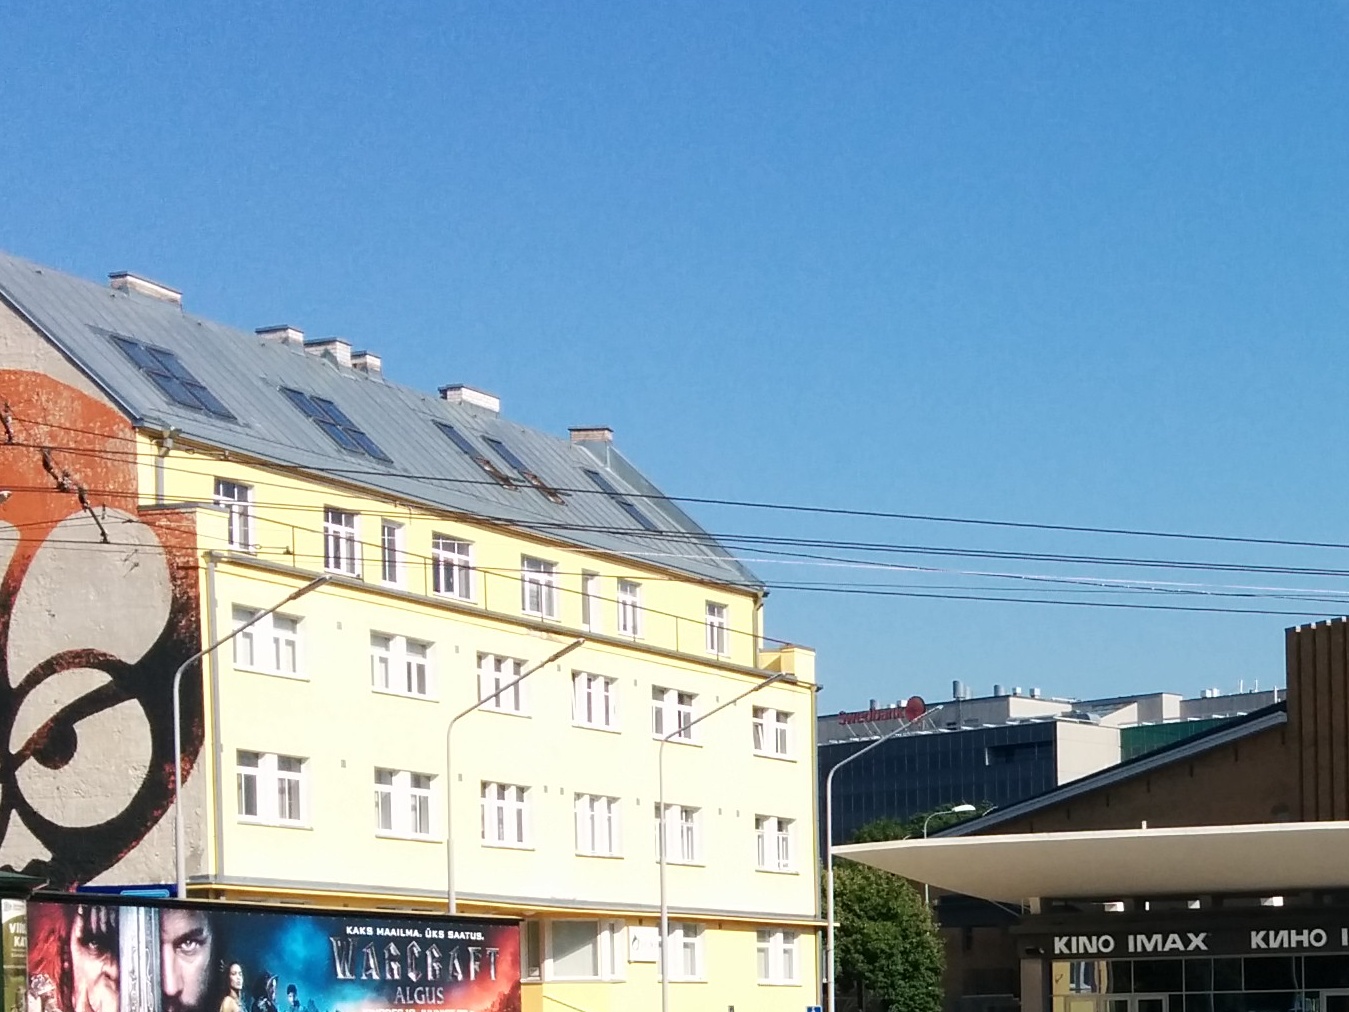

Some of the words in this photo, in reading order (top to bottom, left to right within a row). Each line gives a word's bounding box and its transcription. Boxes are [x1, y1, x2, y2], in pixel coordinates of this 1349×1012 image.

[346, 926, 373, 936] KAKS
[376, 927, 423, 938] MAAILMA.
[425, 927, 445, 939] ÜKS
[447, 930, 484, 941] SAATUS.
[1054, 934, 1115, 955] KINO
[1128, 932, 1211, 953] IMAX
[1250, 928, 1327, 950] КИНО
[330, 936, 500, 983] WARCRAFT
[394, 986, 445, 1005] ALGUS
